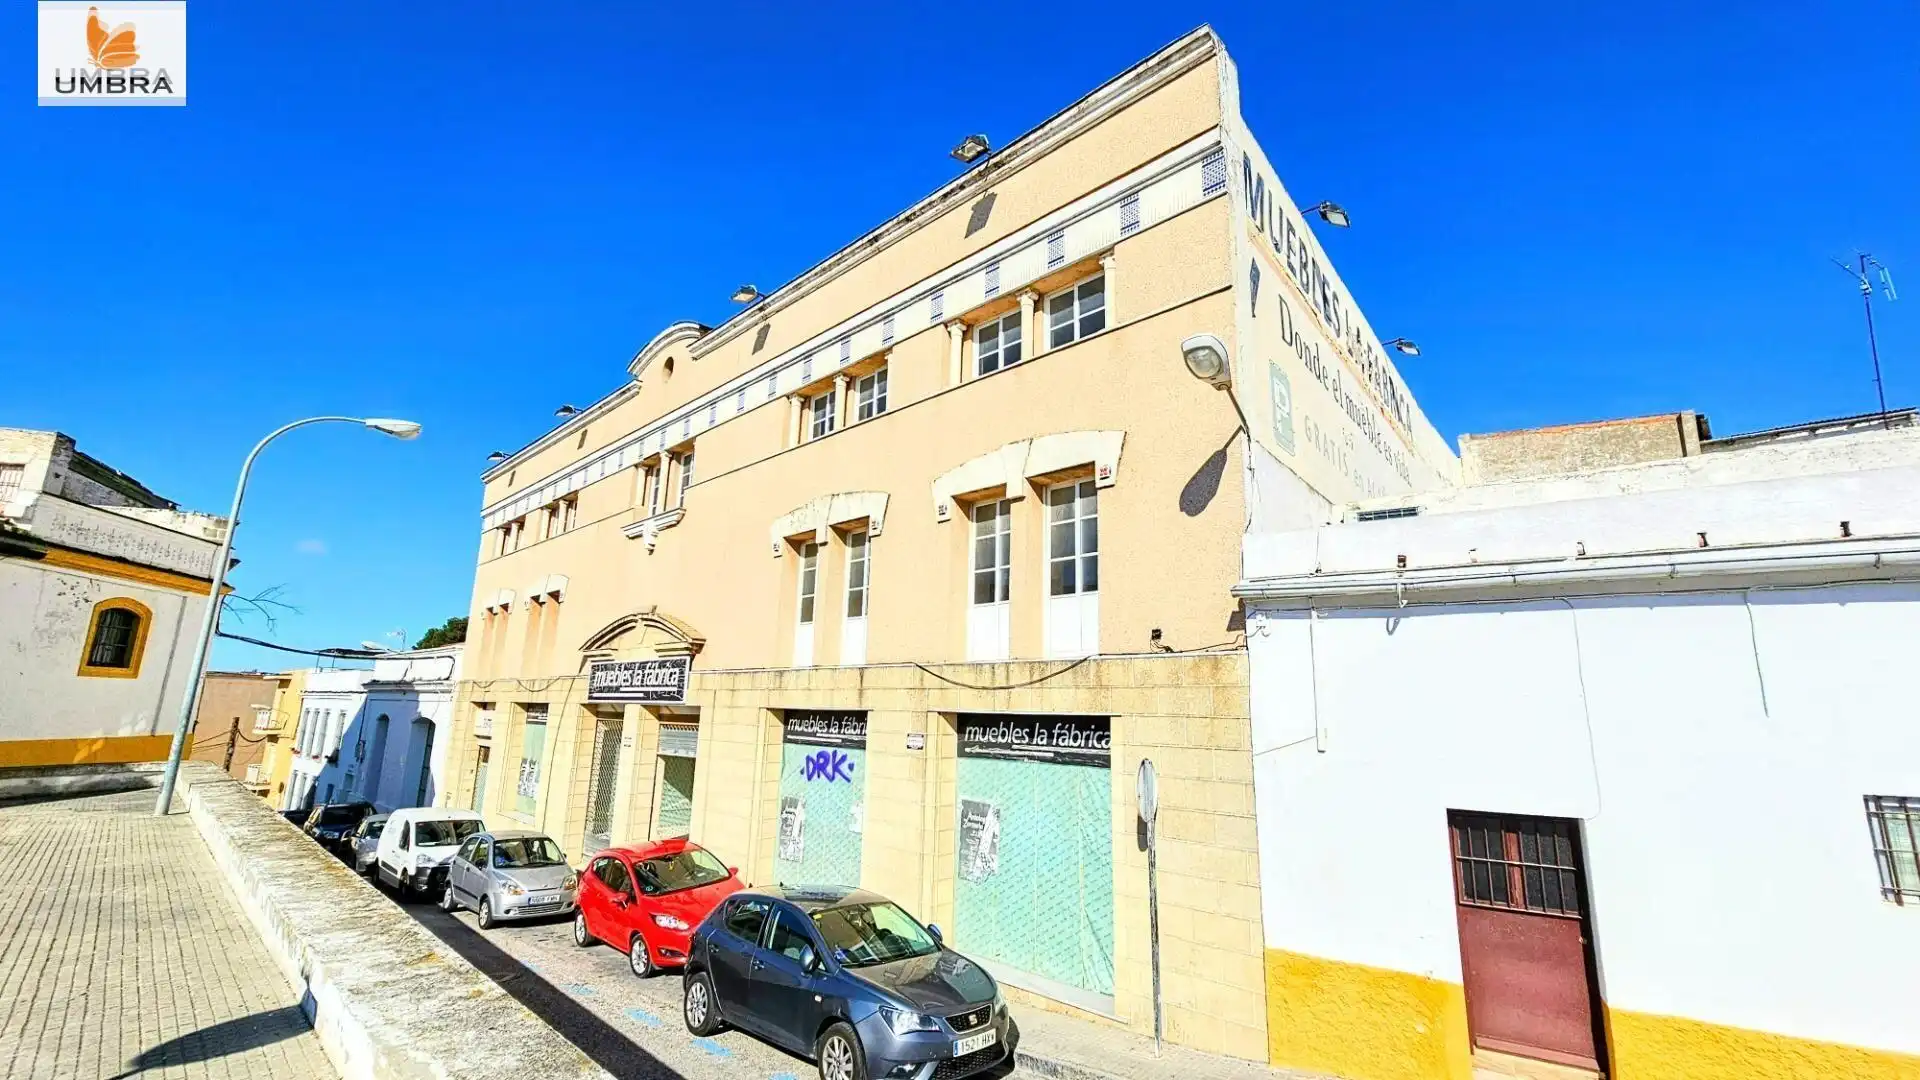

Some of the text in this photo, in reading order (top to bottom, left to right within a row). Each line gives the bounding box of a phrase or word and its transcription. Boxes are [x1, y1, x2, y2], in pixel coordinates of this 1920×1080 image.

[1243, 150, 1340, 339] MUEBLES
[1278, 293, 1329, 392] Donde
[1332, 369, 1344, 410] el
[1304, 414, 1349, 477] GRATIS
[594, 662, 679, 687] muebles la fábrica
[787, 715, 828, 734] muebles
[829, 716, 839, 735] la
[965, 721, 1111, 749] muebles la fábrica
